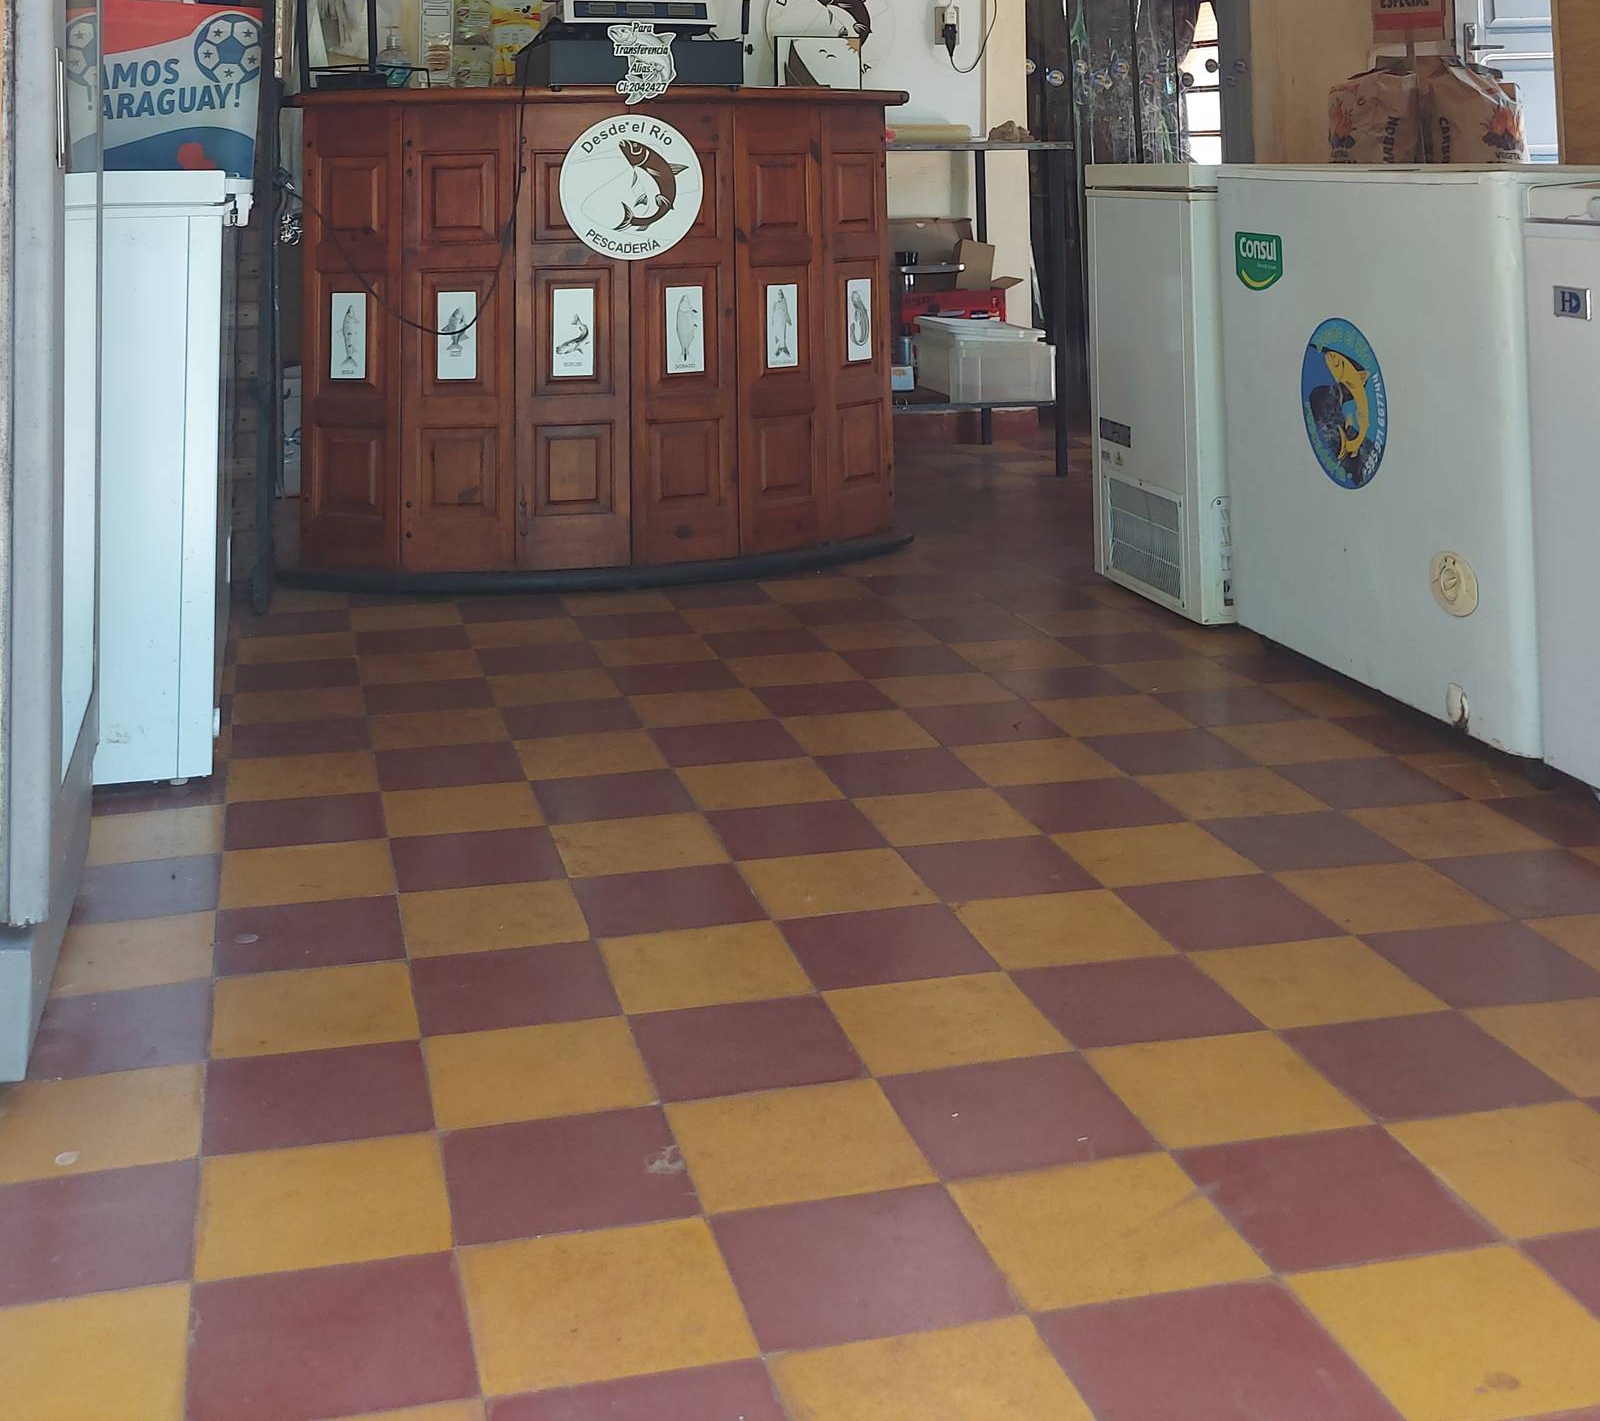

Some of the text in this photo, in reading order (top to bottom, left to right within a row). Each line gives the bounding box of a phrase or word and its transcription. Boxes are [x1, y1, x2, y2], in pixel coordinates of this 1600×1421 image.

[633, 22, 653, 33] Para
[615, 43, 669, 55] Transferencia
[581, 122, 672, 153] Desde el Río
[585, 229, 661, 255] PESCADERÍA
[1240, 237, 1277, 261] Consul
